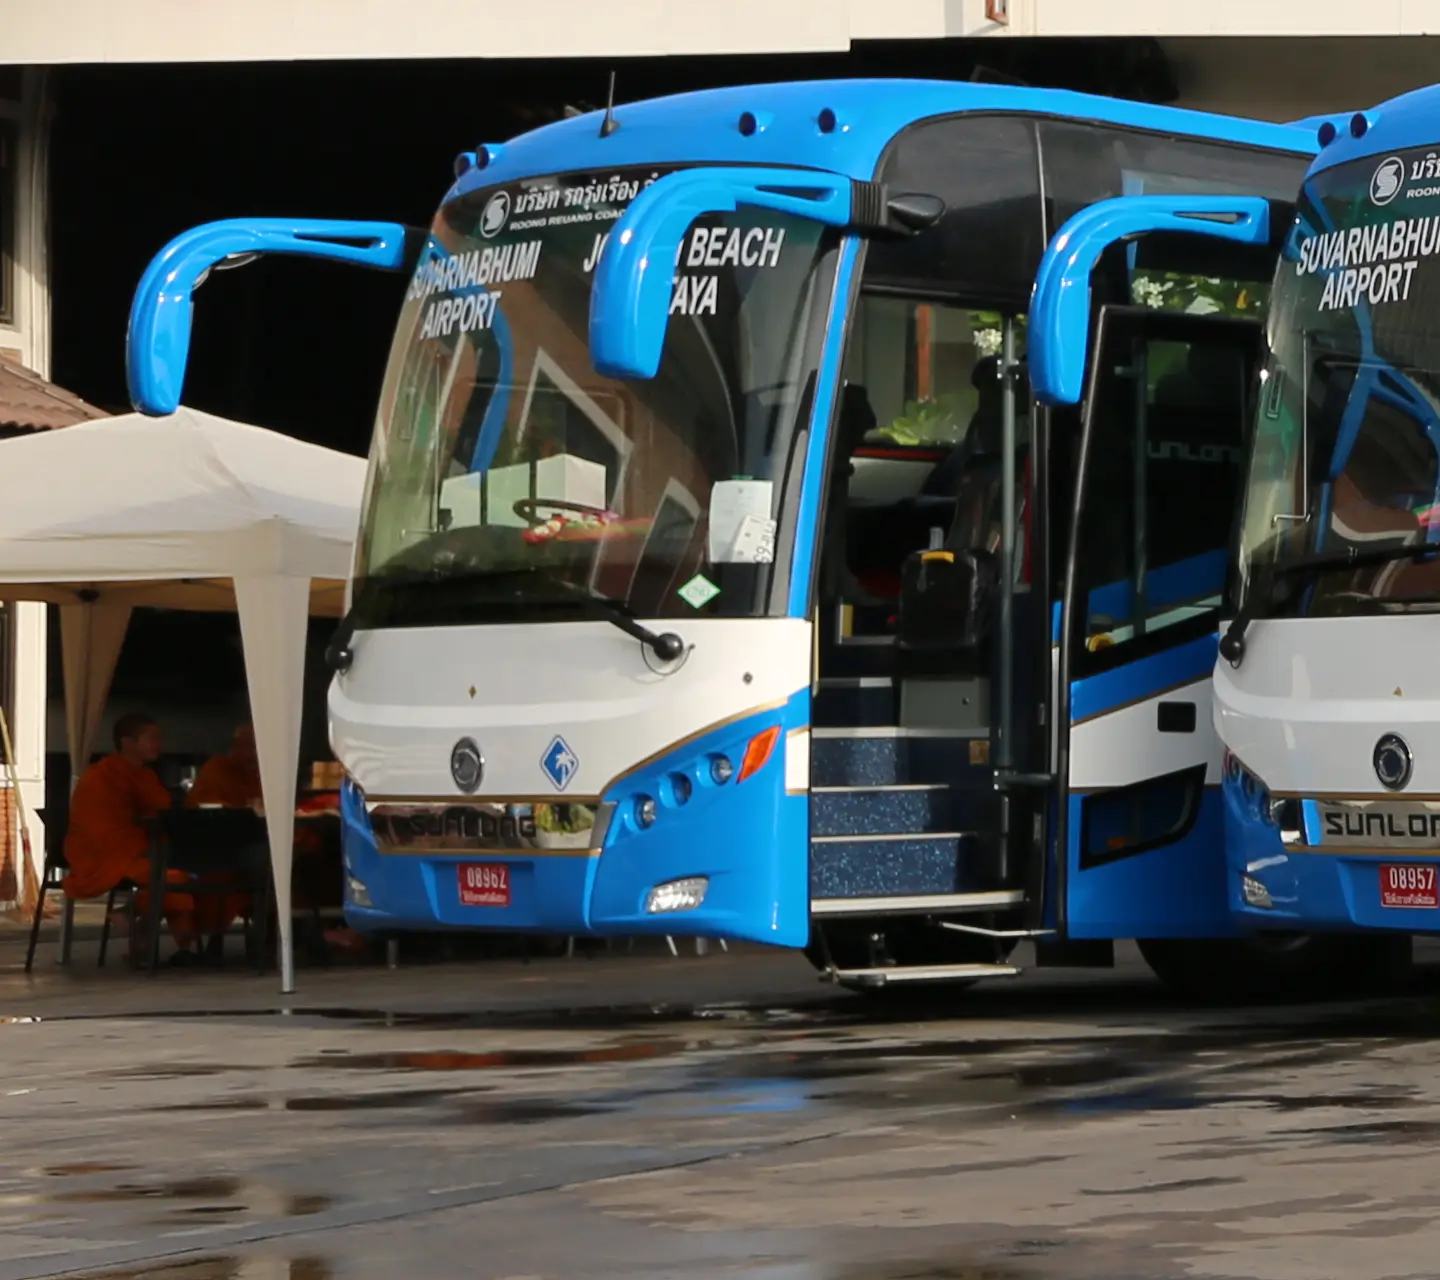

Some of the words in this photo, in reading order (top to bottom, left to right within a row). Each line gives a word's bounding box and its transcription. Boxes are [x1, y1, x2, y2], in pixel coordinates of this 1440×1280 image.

[509, 217, 547, 231] ROONG
[548, 213, 593, 227] REUANG
[594, 209, 626, 222] COAC
[686, 226, 785, 268] BEACH
[408, 240, 542, 301] SUVARNABHUMI
[1318, 261, 1417, 312] AIRPORT
[420, 290, 503, 340] AIRPORT
[467, 867, 507, 889] 08962
[1389, 867, 1435, 890] 08957
